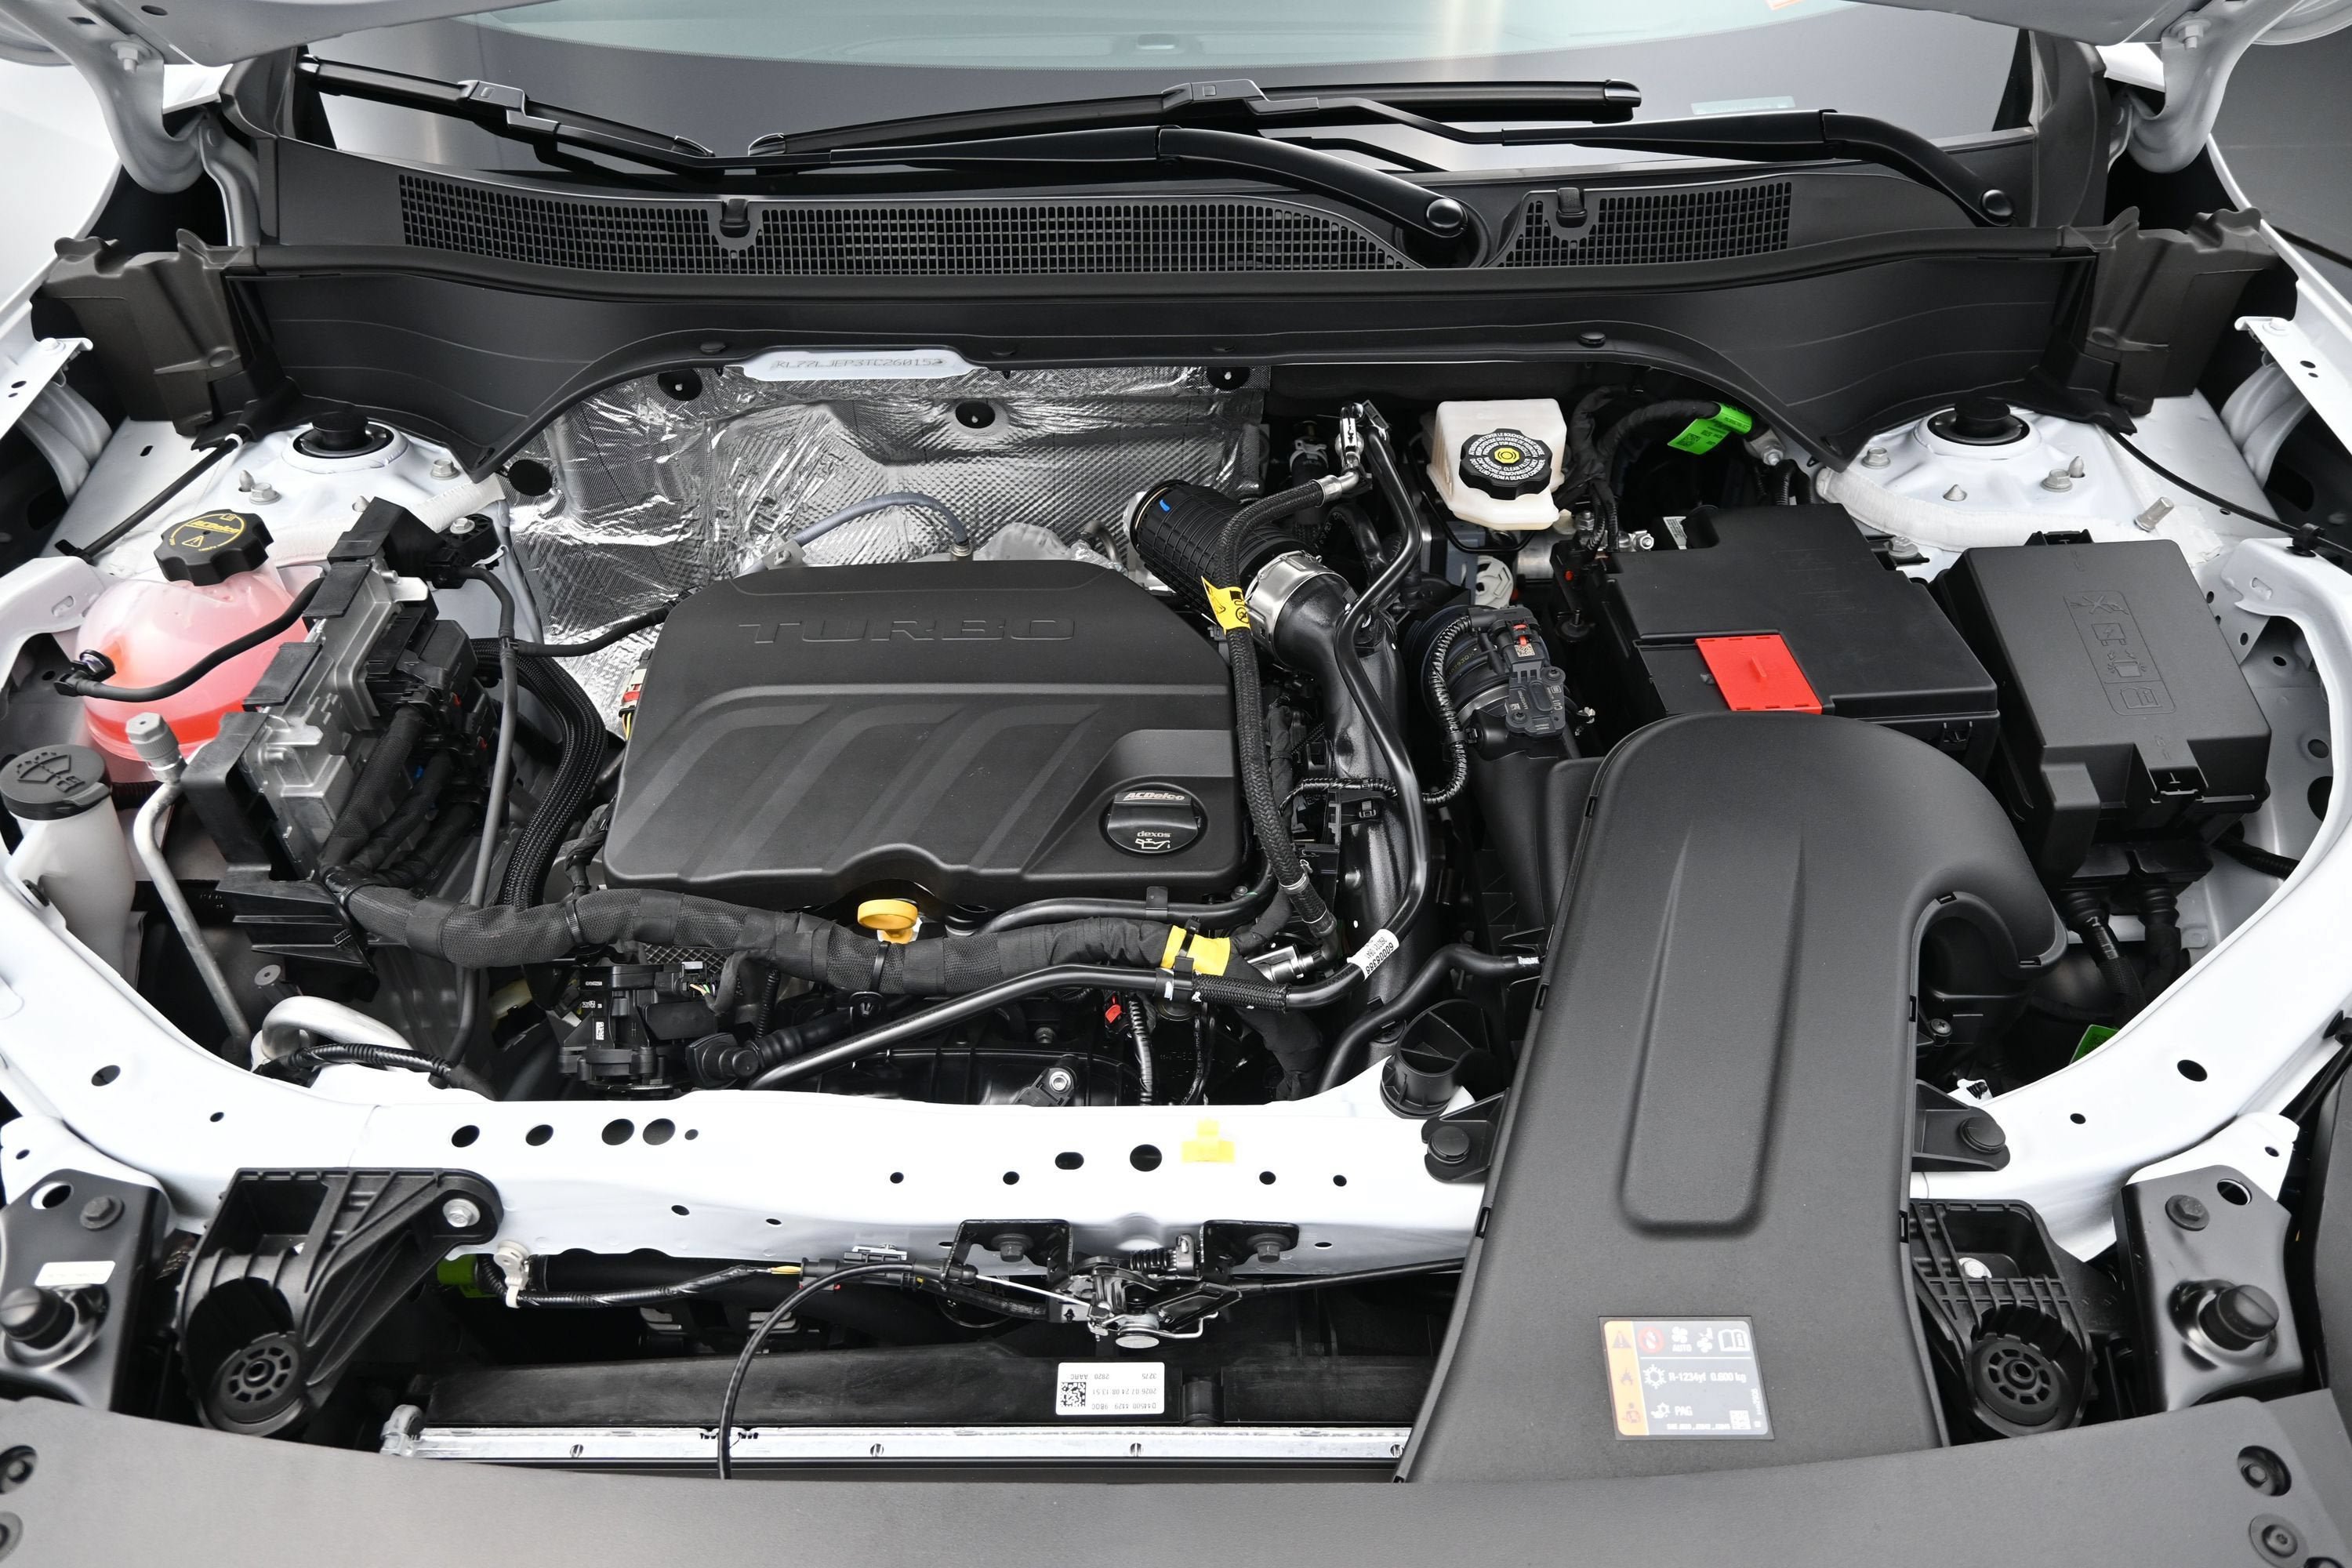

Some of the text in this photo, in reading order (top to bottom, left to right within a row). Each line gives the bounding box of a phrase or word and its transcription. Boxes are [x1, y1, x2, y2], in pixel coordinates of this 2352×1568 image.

[739, 619, 1076, 644] TURBO
[1122, 792, 1185, 801] ACDelco
[1365, 942, 1395, 975] 60008388
[1672, 1344, 1693, 1352] AUTO
[1675, 1406, 1693, 1417] PAG
